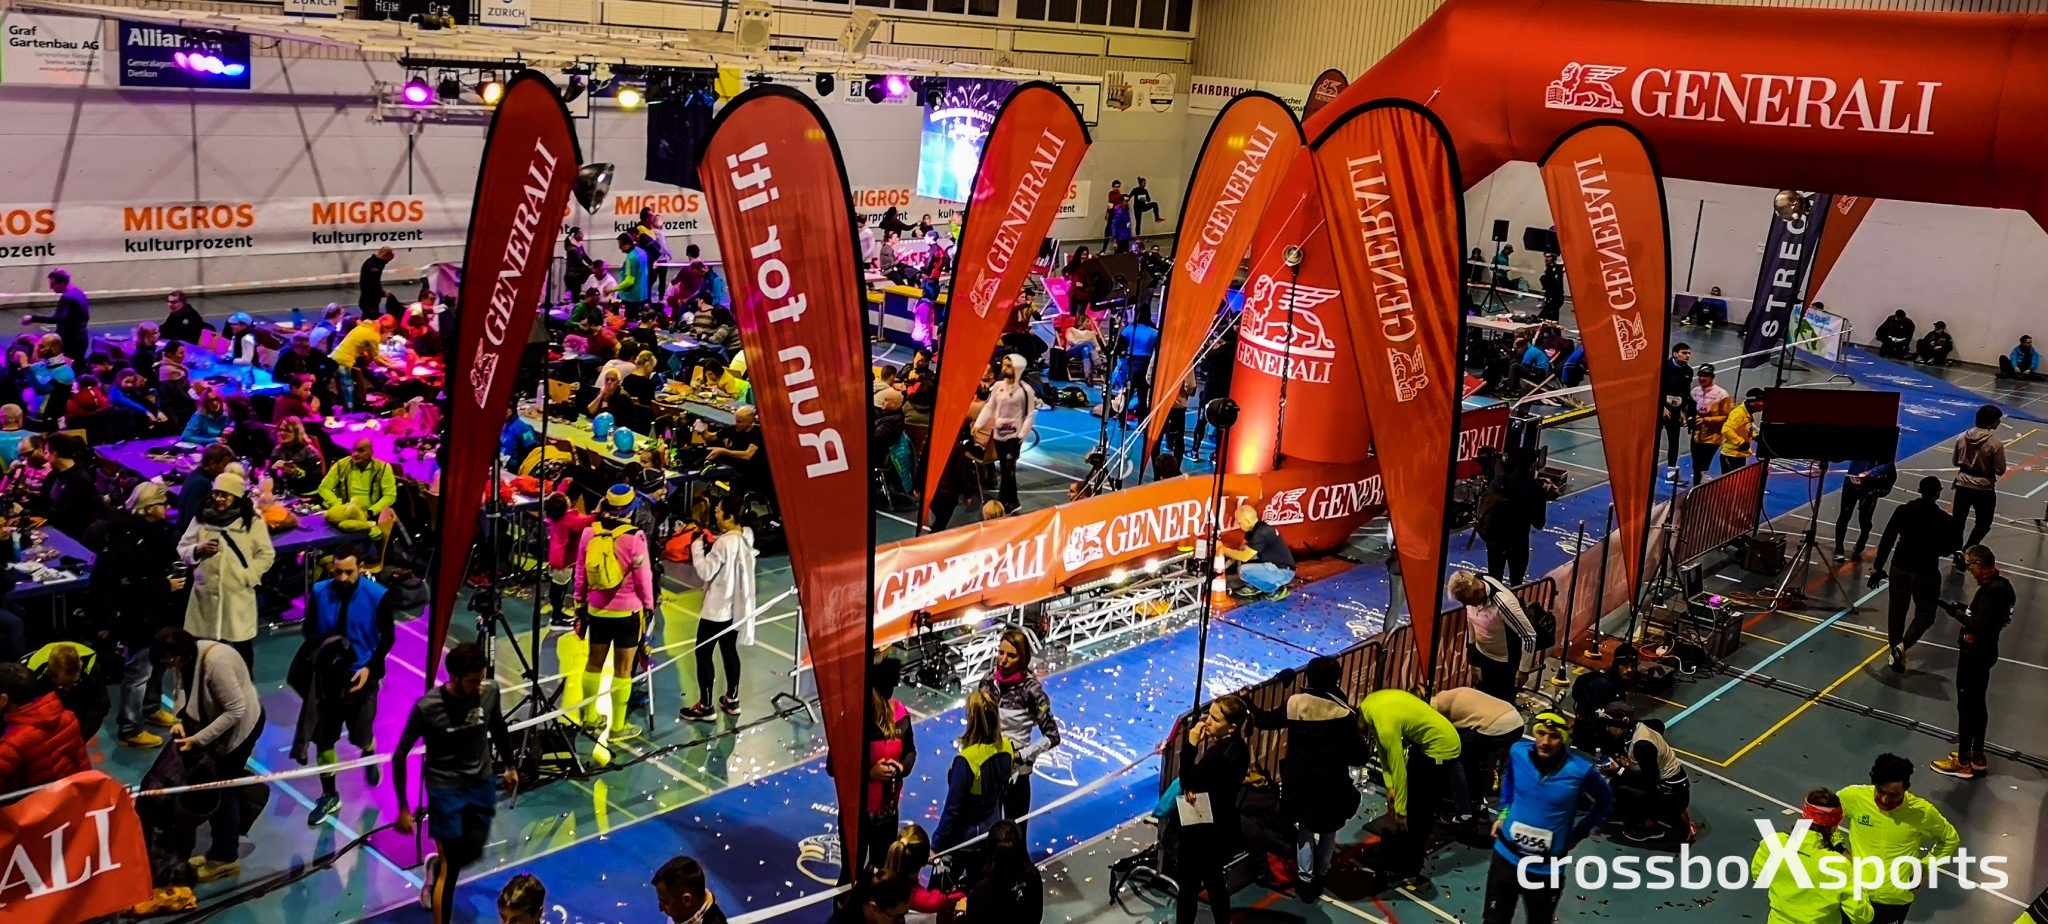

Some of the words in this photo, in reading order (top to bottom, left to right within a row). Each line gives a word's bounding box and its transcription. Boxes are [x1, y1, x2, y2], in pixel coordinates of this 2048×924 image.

[9, 25, 37, 36] Graf
[127, 28, 198, 48] Allia
[9, 37, 78, 50] Gartenbau
[81, 40, 99, 50] AG
[127, 69, 158, 78] Dietikon
[1191, 83, 1253, 98] FAIRDRUC
[1630, 67, 1942, 135] GENERALI
[1201, 121, 1279, 246] GENERALI
[312, 200, 425, 225] MIGROS
[614, 194, 699, 216] MIGROS
[986, 127, 1066, 274] GENERALI
[0, 208, 56, 236] OS
[123, 203, 254, 232] MIGROS
[125, 235, 253, 254] kulturprozent
[312, 229, 423, 246] kulturprozent
[485, 137, 560, 346] GENERALI
[1236, 341, 1333, 384] GENERALI
[1308, 474, 1384, 521] GENER
[876, 534, 1048, 615] GENERALI
[1515, 832, 1545, 849] 5056
